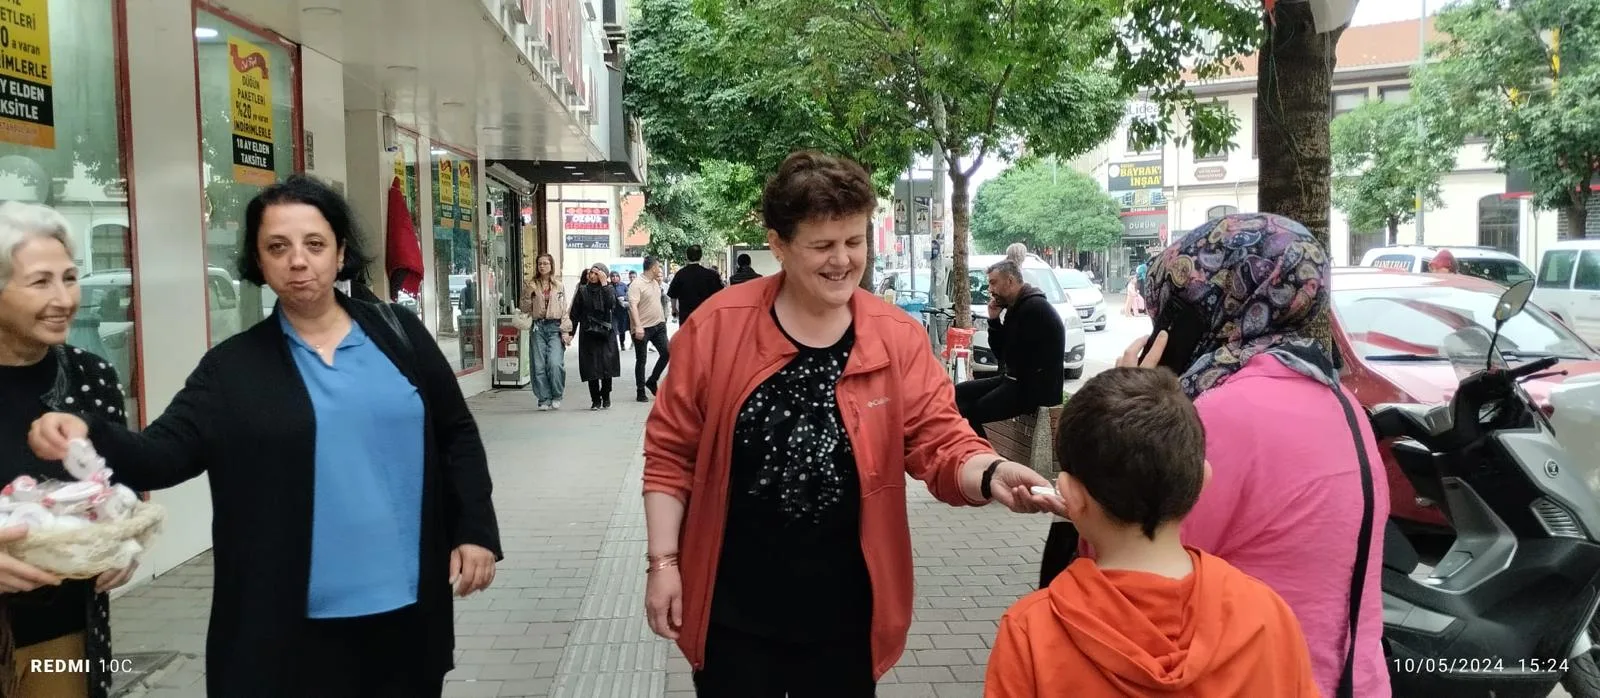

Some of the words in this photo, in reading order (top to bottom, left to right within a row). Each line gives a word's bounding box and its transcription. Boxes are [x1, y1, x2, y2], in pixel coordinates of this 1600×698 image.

[18, 41, 40, 55] varan
[0, 50, 47, 79] İMLERLE
[242, 74, 260, 89] DÜĞÜN
[10, 80, 45, 102] ELDEN
[237, 88, 266, 105] PAKETLERİ
[236, 101, 251, 119] %20
[244, 140, 252, 151] AY
[252, 142, 270, 155] ELDEN
[241, 153, 267, 168] TAKSİTLE
